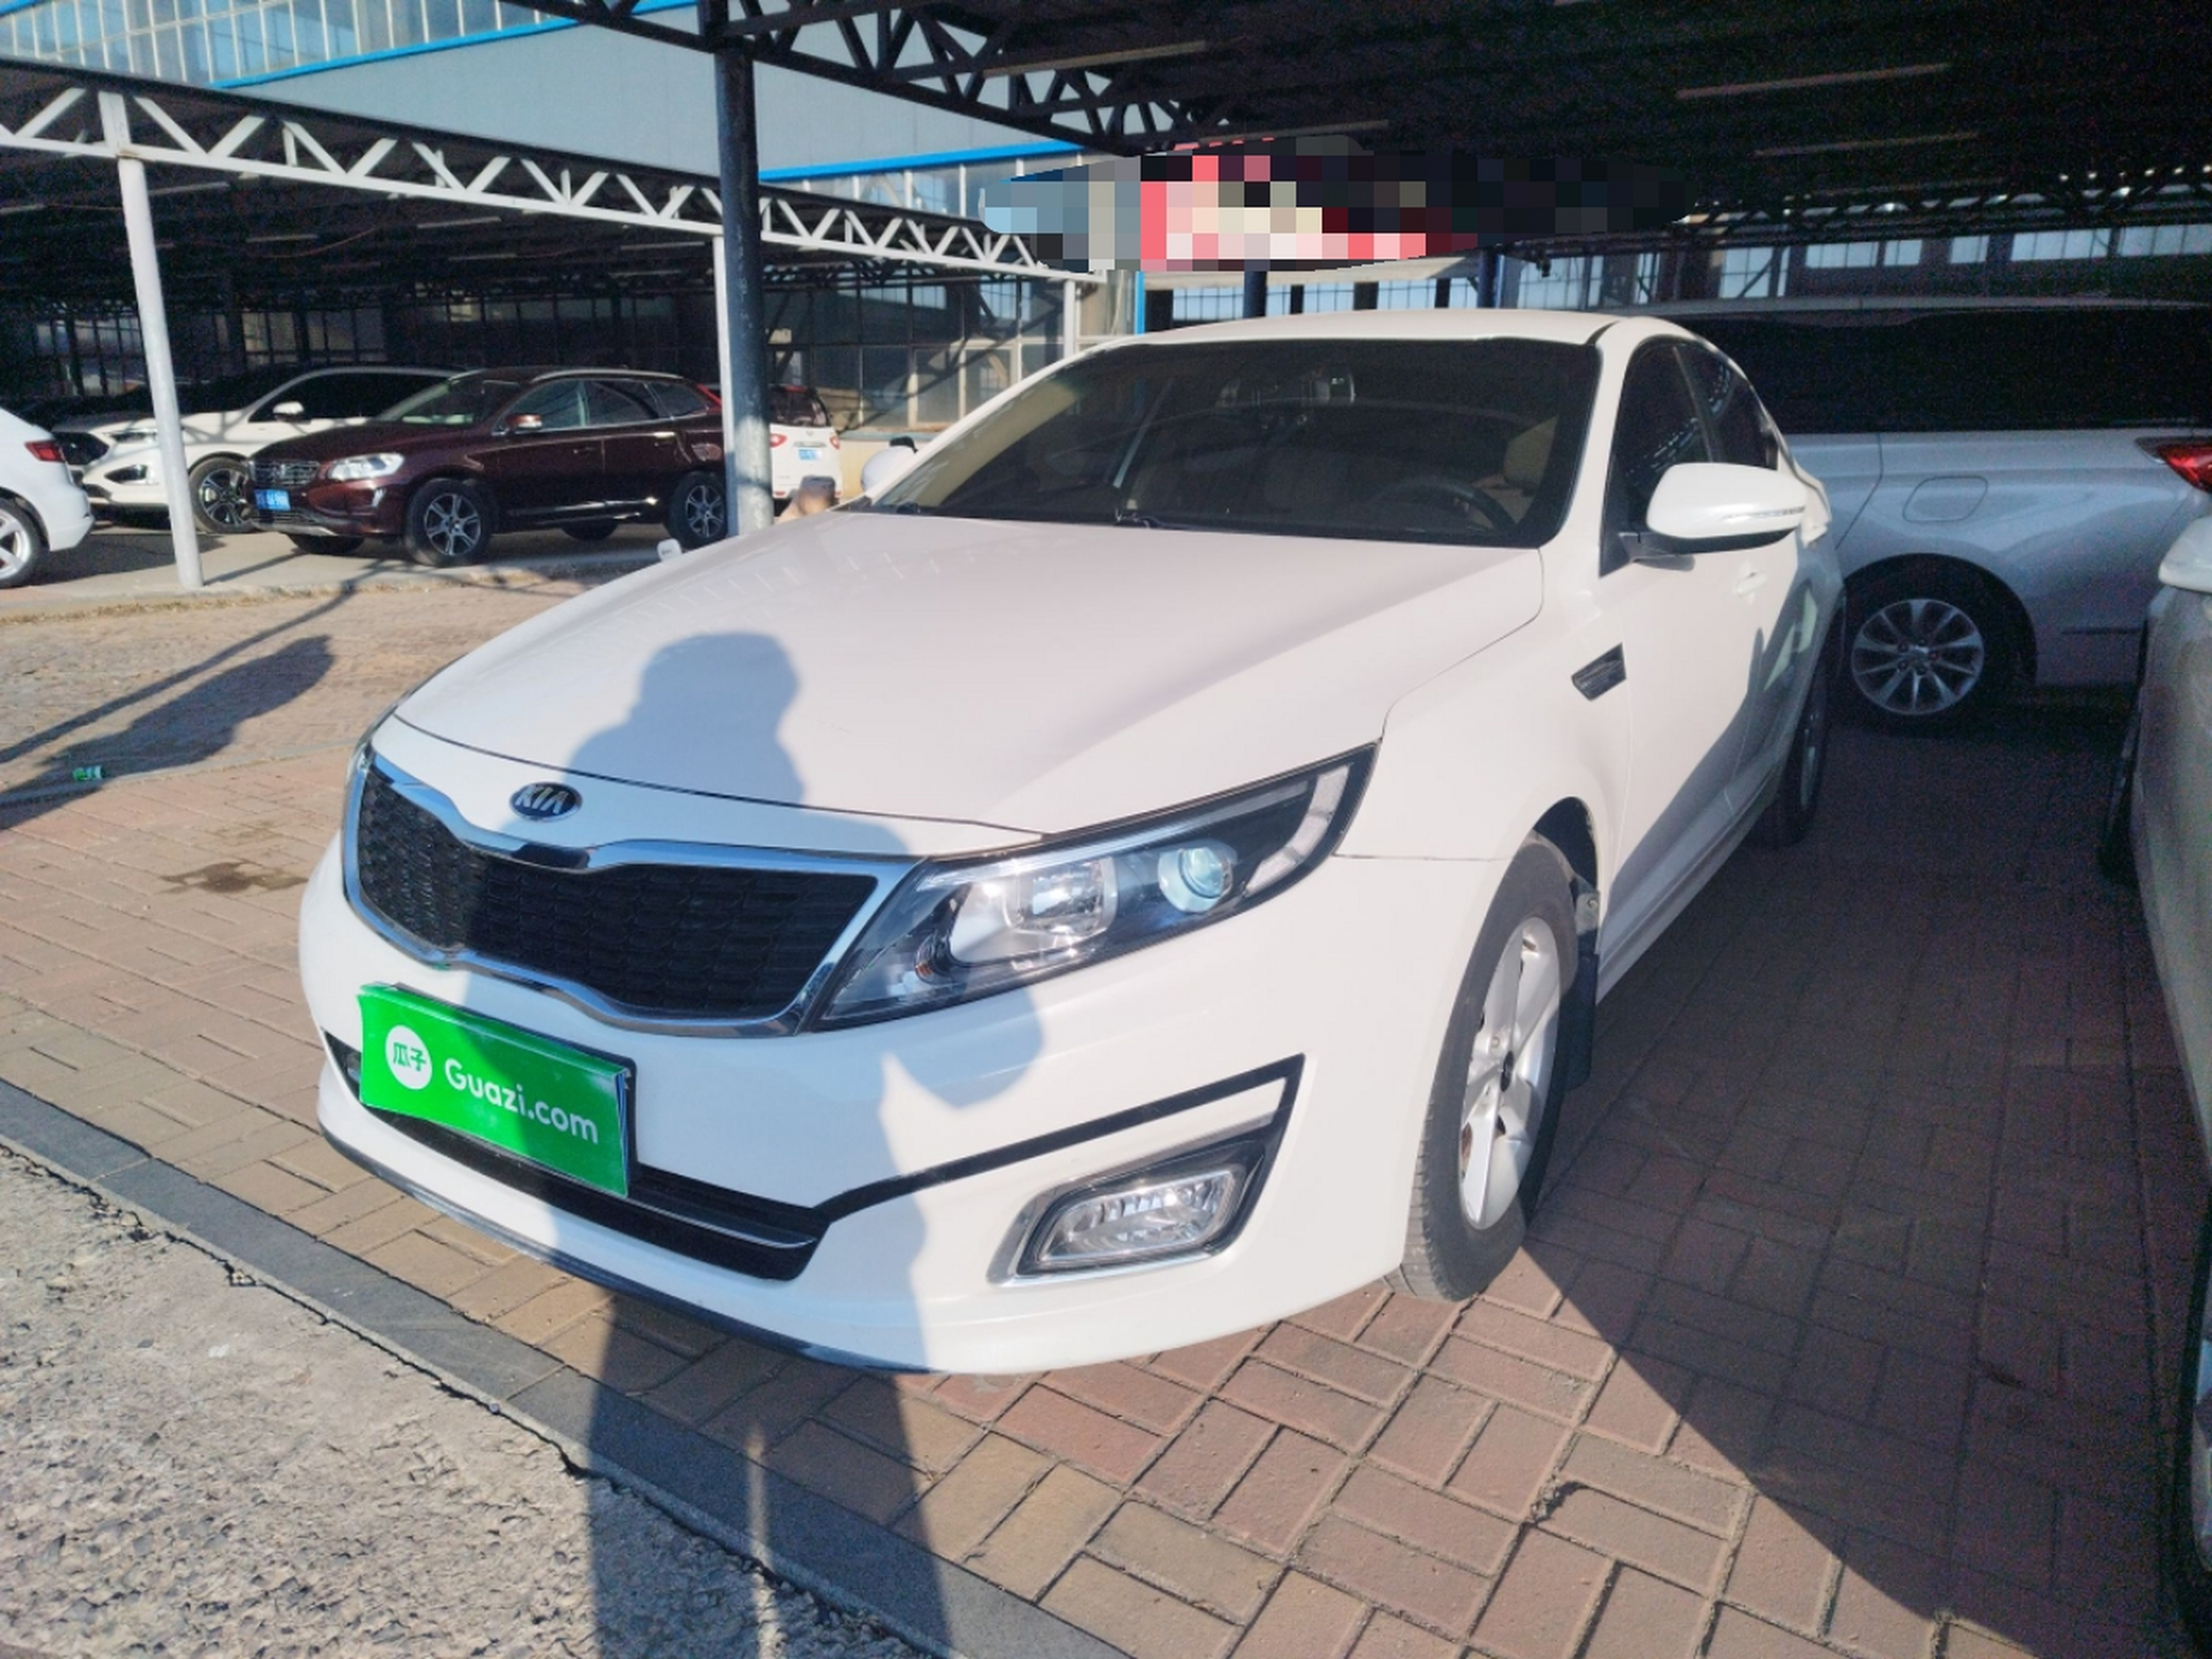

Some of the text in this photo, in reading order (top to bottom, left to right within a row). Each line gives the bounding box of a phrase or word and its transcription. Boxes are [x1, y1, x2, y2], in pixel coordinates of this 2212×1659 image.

[514, 785, 569, 814] KIA
[393, 1041, 427, 1071] 瓜子
[444, 1058, 599, 1144] Guazi.com
